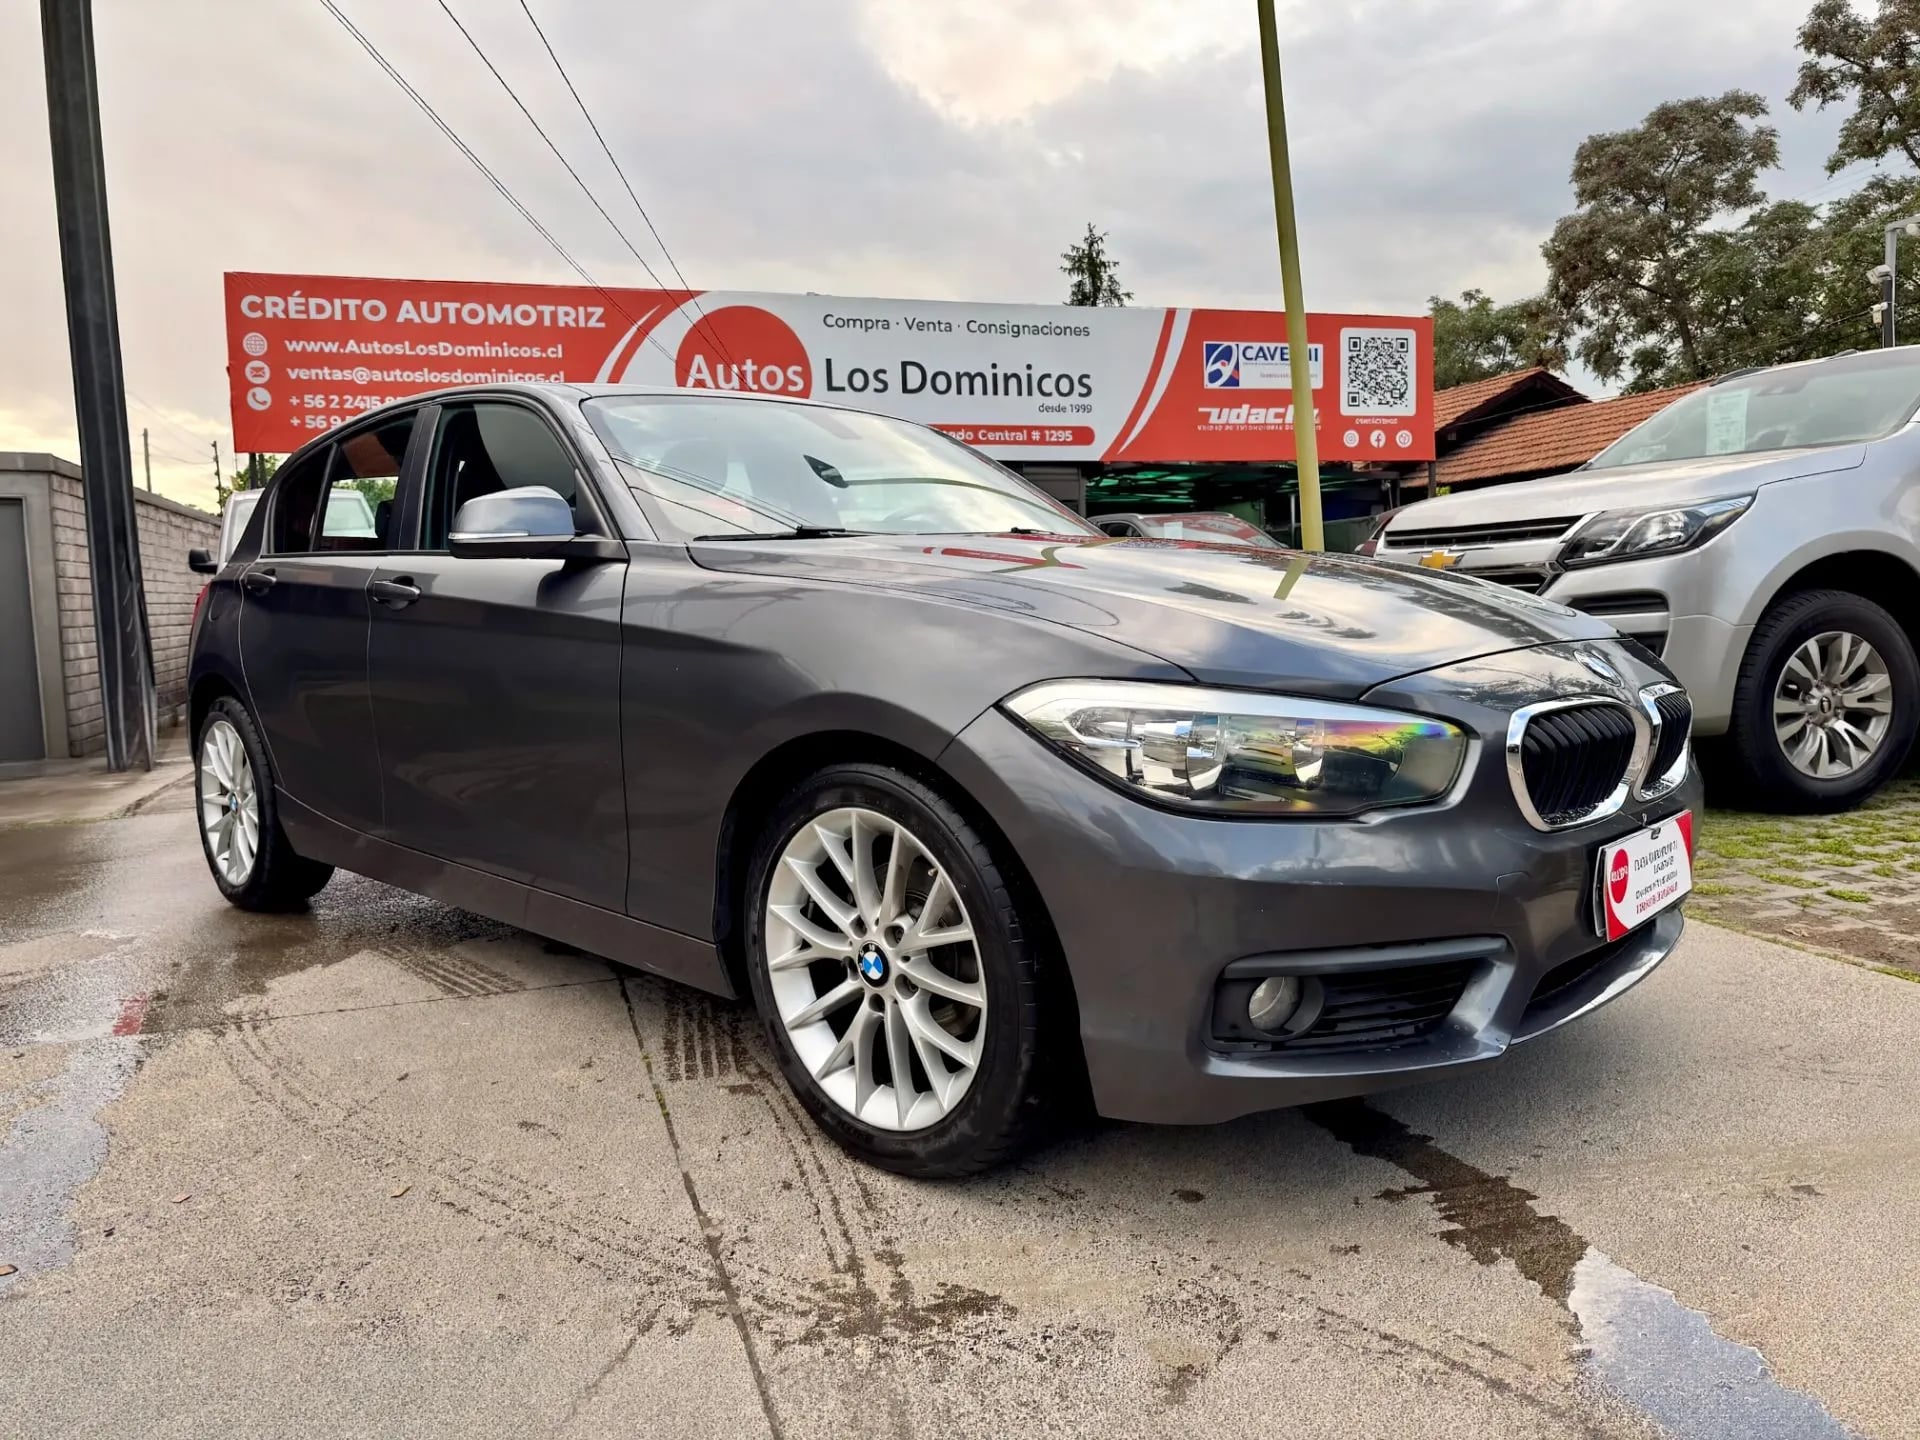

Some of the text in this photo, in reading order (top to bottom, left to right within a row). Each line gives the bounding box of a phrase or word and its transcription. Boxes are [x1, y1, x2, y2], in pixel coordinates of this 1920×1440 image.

[240, 291, 606, 328] CRÉDITO AUTOMOTRIZ
[823, 314, 1090, 337] Compra Venta Consignaciones
[285, 339, 562, 358] www.AutosLosDominicos.cl
[286, 366, 564, 384] ventas@autoslosdominicos.cl
[685, 354, 804, 391] Autos
[825, 358, 1093, 398] Los Dominicos
[304, 394, 326, 409] 56
[329, 395, 340, 409] 2
[343, 395, 381, 409] 2415
[1038, 403, 1092, 413] desde 1999
[305, 415, 327, 429] 56
[978, 429, 1027, 441] Central
[1044, 430, 1073, 442] 1295
